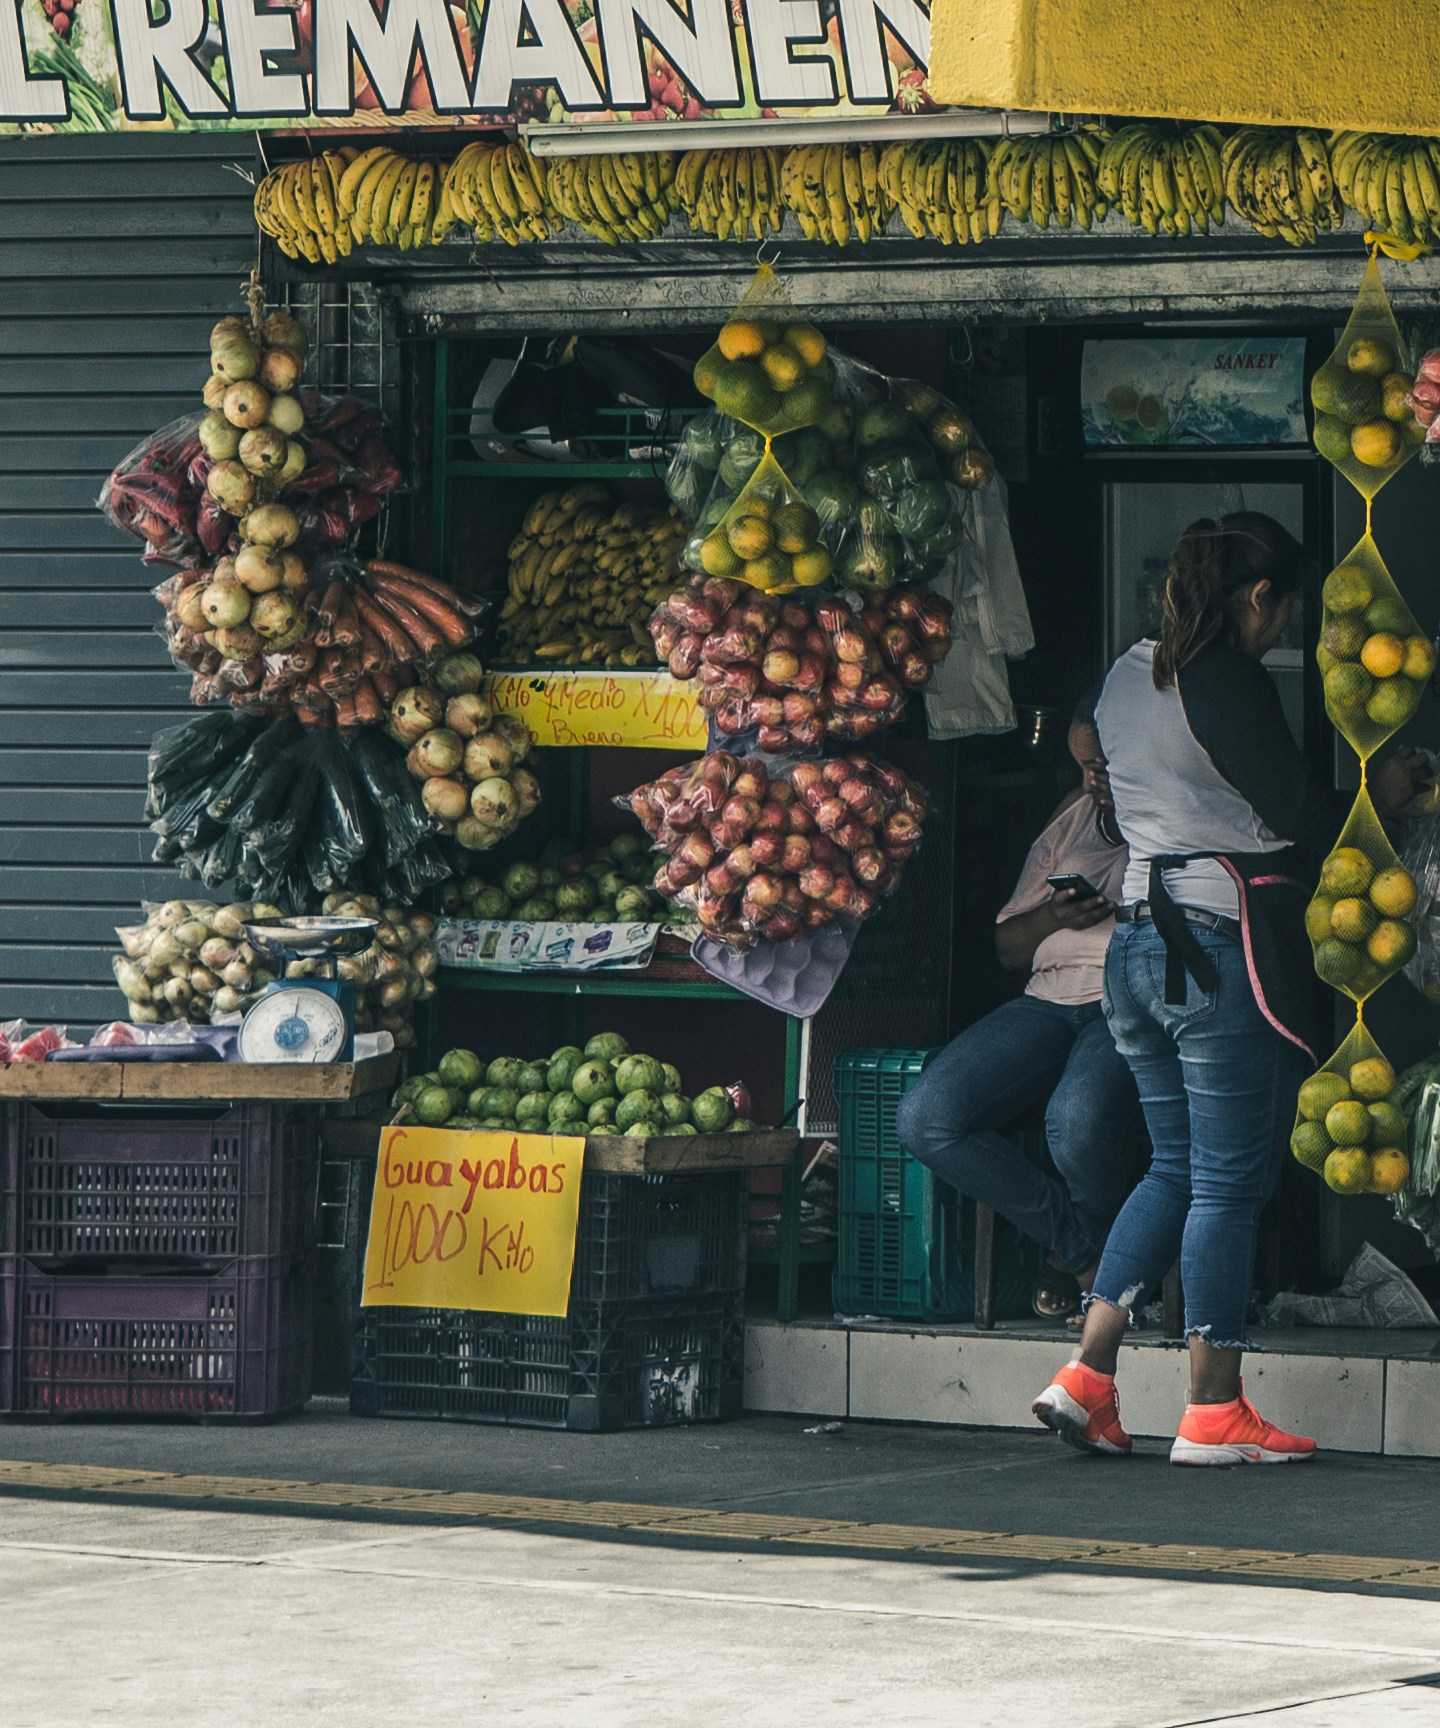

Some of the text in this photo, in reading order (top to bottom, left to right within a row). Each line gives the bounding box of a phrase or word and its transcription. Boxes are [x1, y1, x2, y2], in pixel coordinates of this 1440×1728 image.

[1214, 353, 1279, 370] SANKEY
[489, 674, 531, 712] Kilo
[560, 676, 626, 716] Medio
[383, 1128, 566, 1215] Guayabas
[368, 1194, 534, 1291] 1000 Kilo
